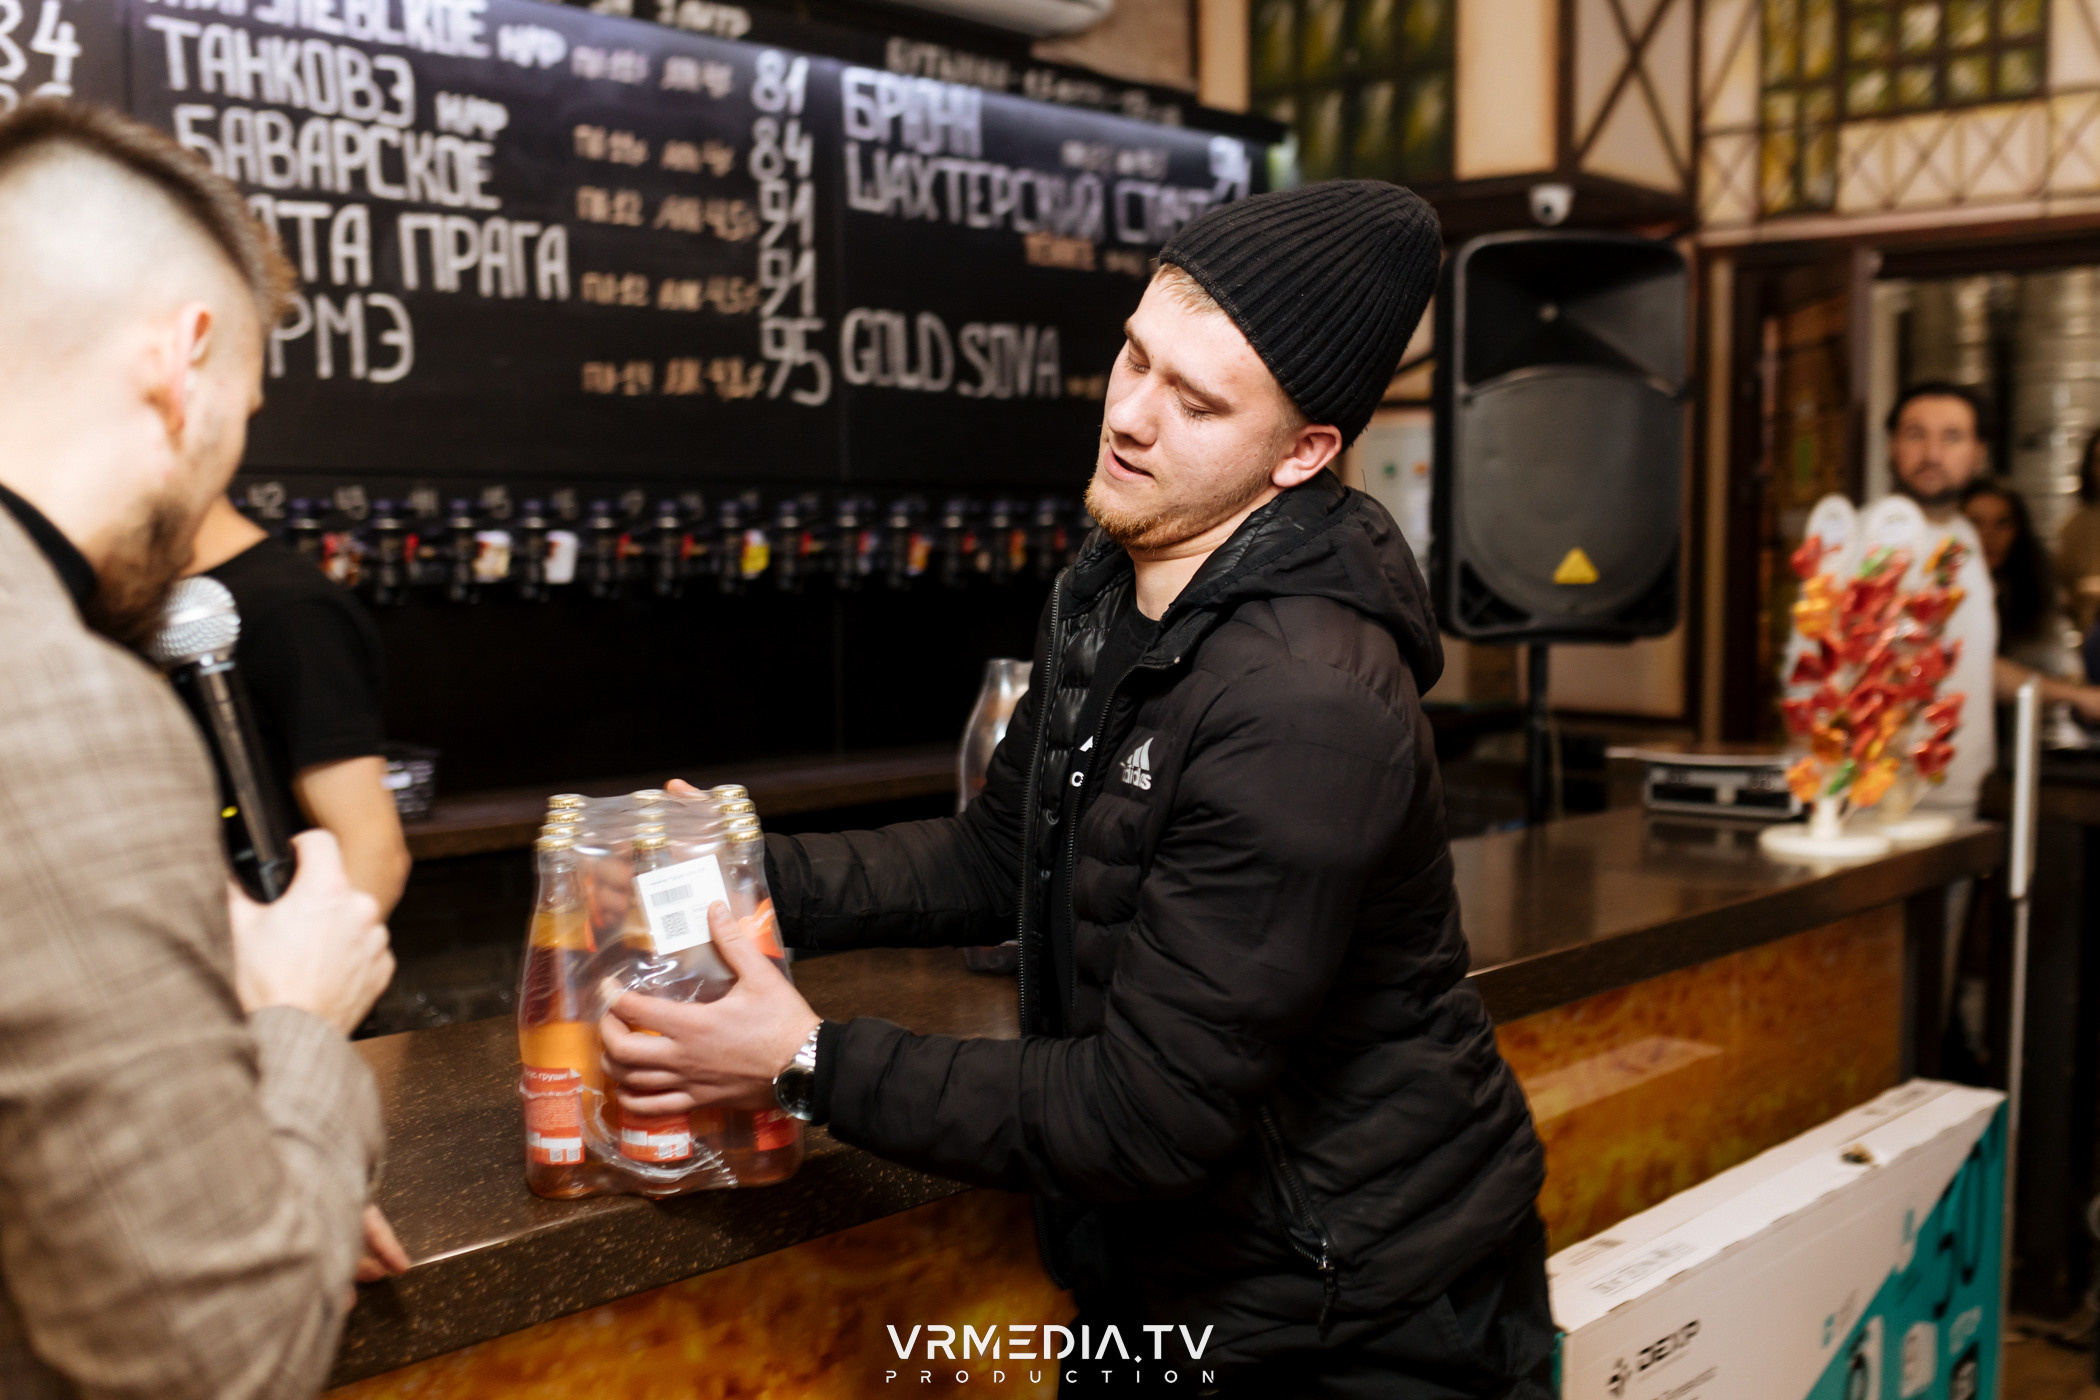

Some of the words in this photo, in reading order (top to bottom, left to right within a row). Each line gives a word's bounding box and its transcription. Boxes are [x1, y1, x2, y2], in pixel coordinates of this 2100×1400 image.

[146, 14, 416, 128] ТАНКОВЭ
[750, 115, 813, 182] 84
[752, 50, 810, 115] 81
[173, 102, 501, 210] БАВАРСКОЕ
[758, 180, 815, 248] 91
[397, 212, 569, 300] ПРАГА
[758, 247, 817, 319] 91
[760, 316, 833, 406] 95
[839, 307, 954, 393] GOLD
